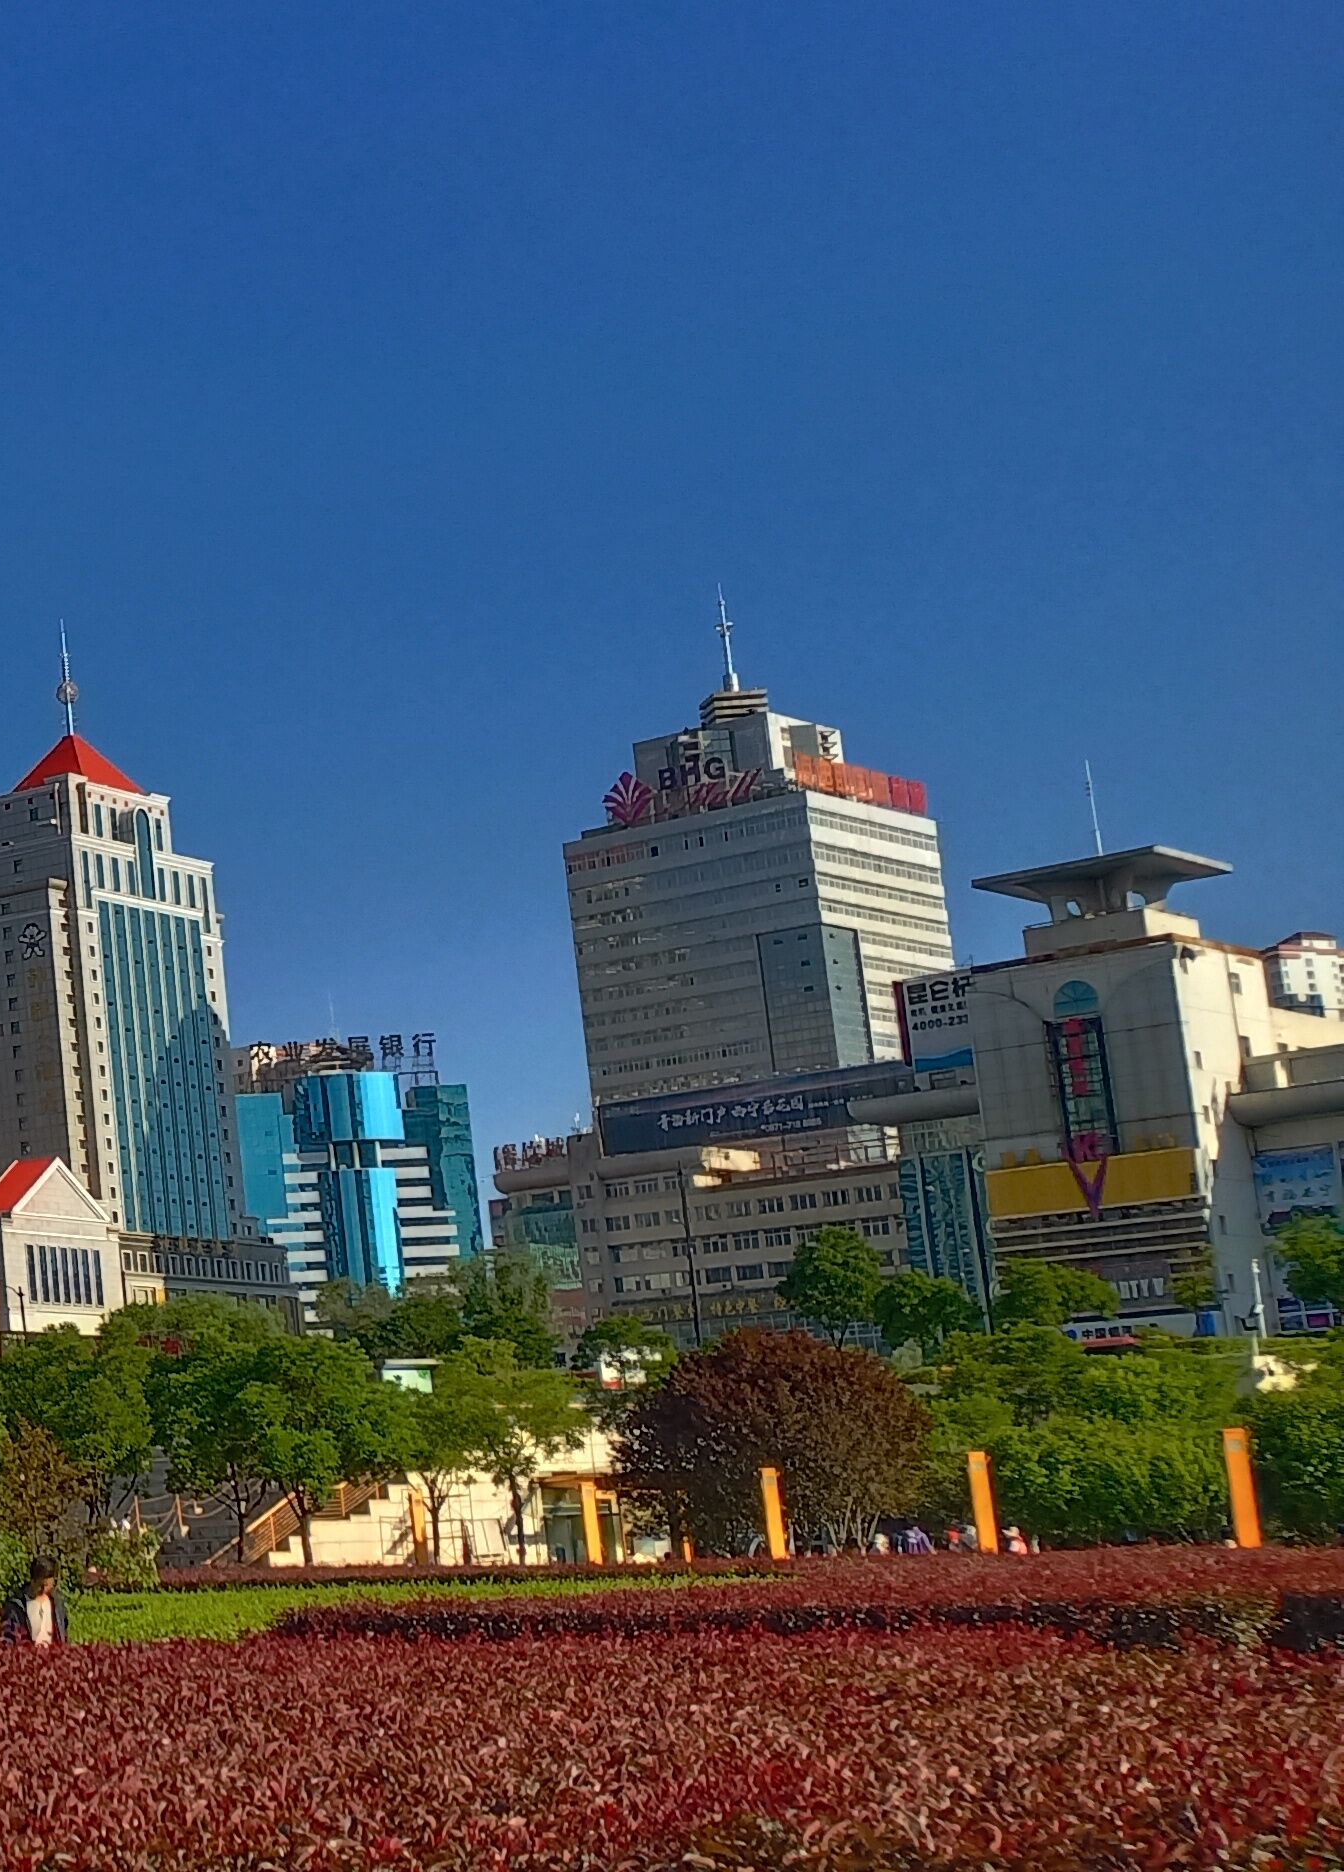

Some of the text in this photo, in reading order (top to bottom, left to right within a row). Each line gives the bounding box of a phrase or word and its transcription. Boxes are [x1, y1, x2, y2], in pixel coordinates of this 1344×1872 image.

[658, 754, 726, 791] BHG
[250, 1032, 436, 1062] 农业发展银行
